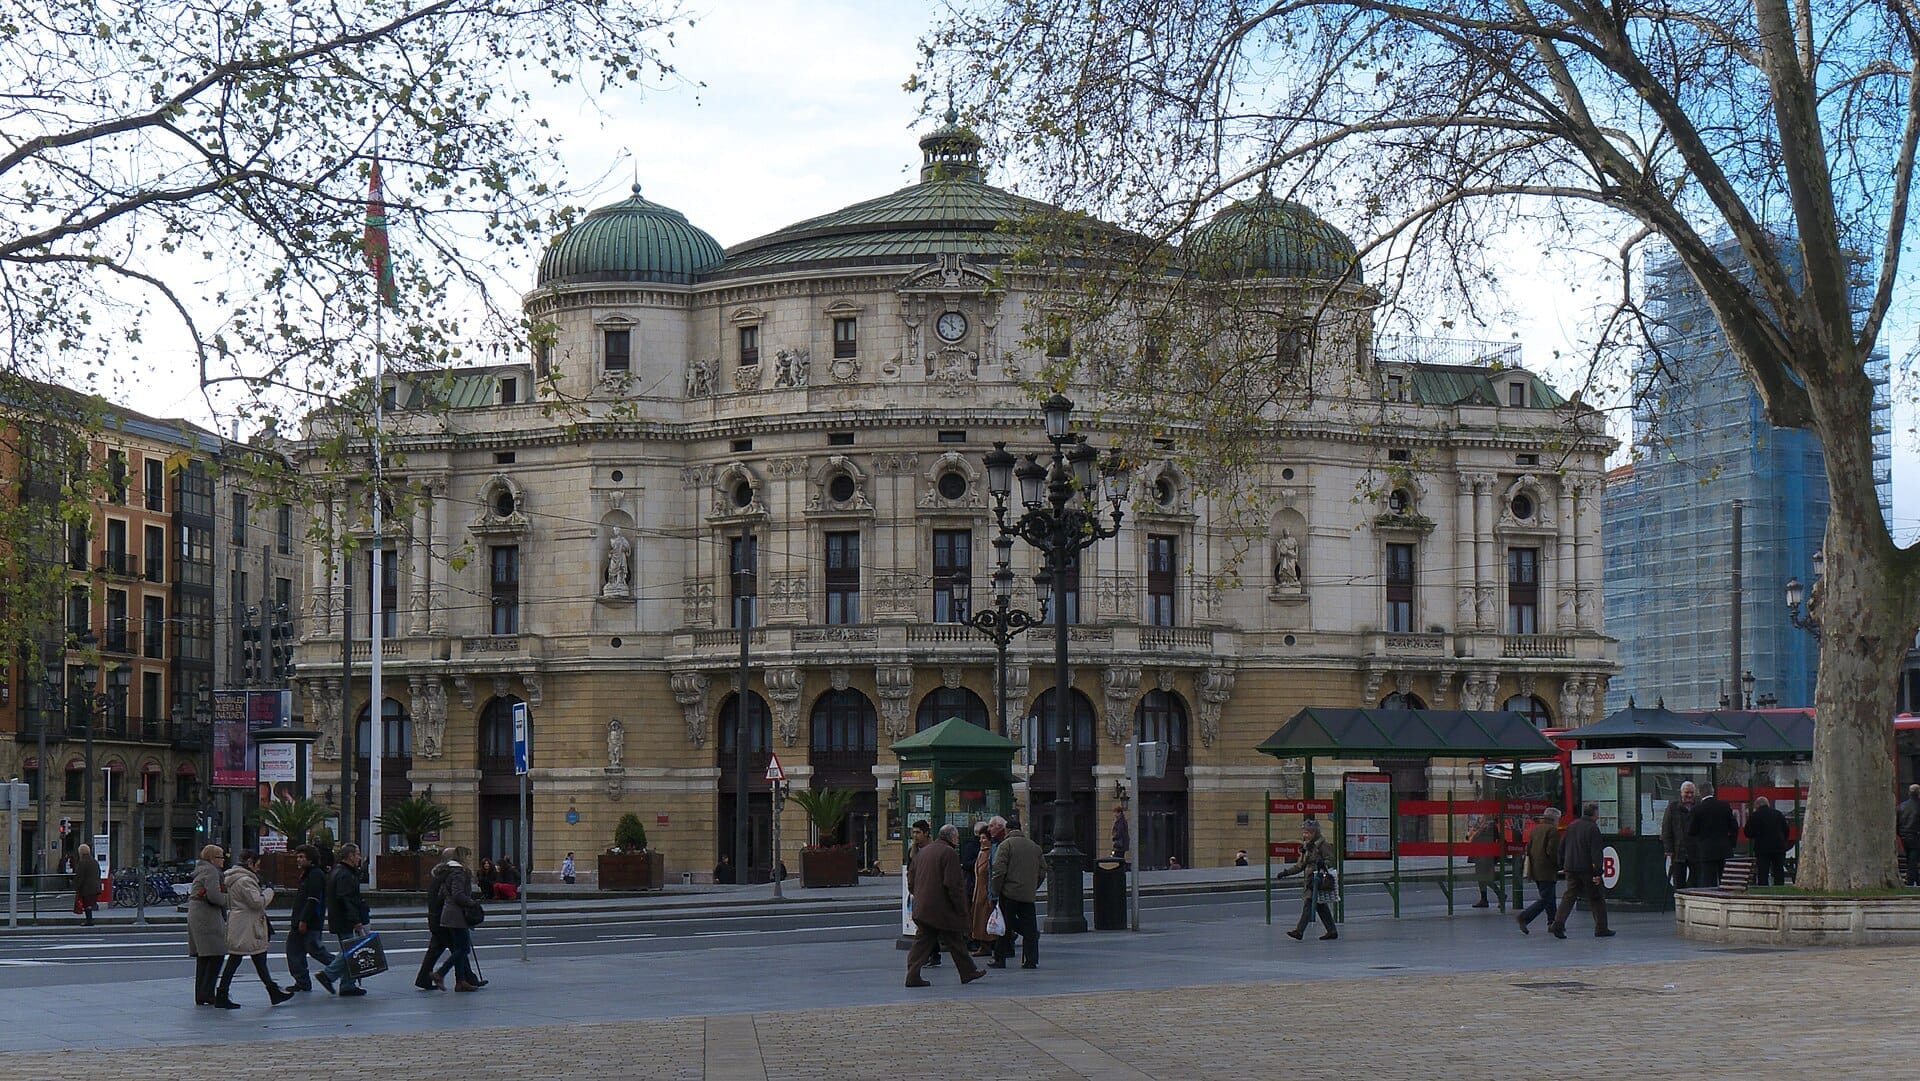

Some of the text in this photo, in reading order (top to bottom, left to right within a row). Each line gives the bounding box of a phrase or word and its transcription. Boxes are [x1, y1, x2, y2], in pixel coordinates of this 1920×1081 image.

[1592, 752, 1616, 760] Bilbobus
[1666, 751, 1693, 759] Bilbobus
[1603, 857, 1616, 878] B
